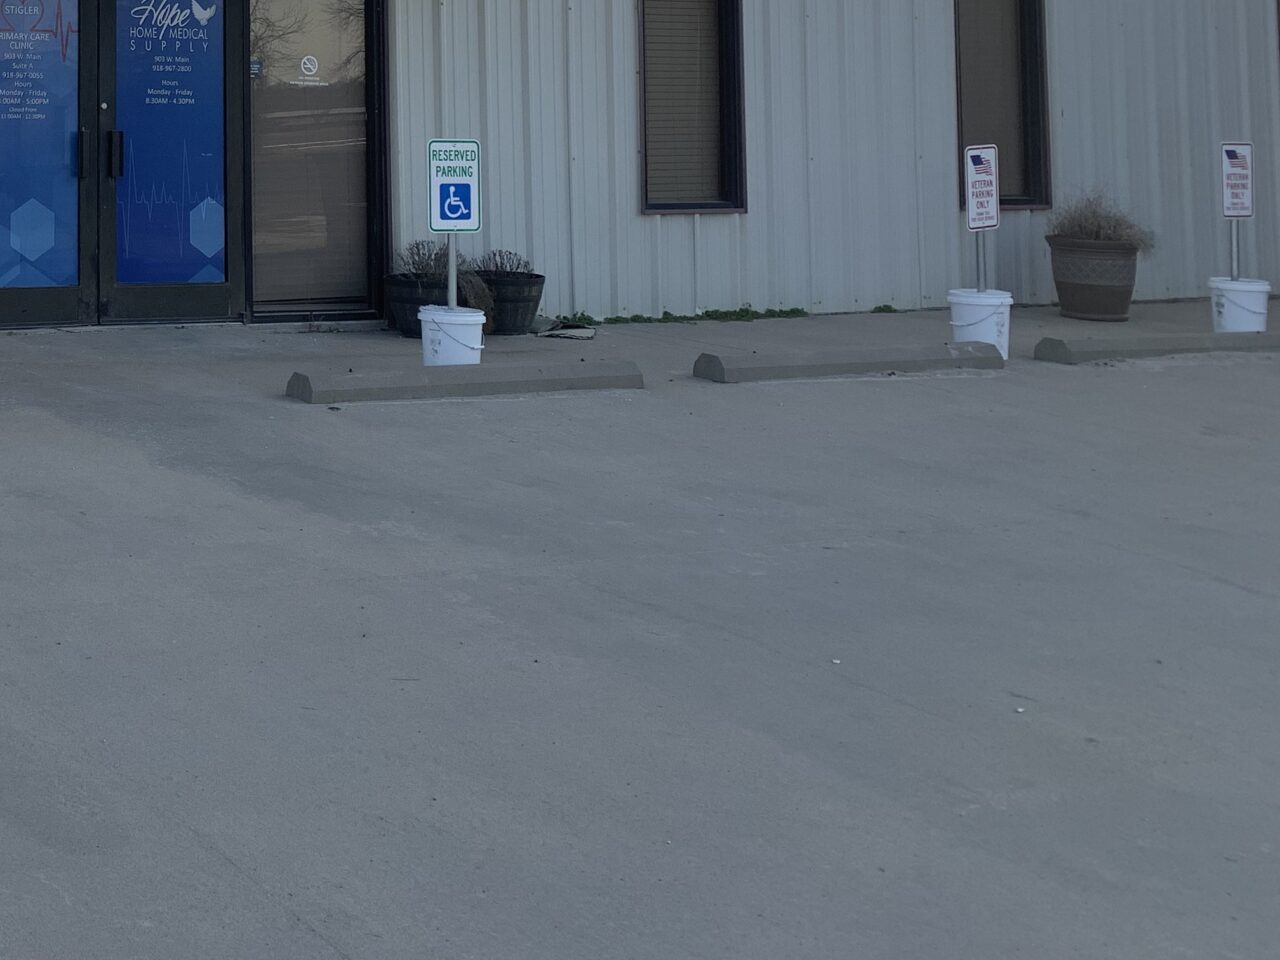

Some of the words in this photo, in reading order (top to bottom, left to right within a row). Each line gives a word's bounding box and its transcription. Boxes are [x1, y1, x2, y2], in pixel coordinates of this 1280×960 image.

[5, 6, 40, 15] STIGLER
[30, 33, 50, 41] CARE
[130, 27, 158, 38] HOME
[169, 28, 208, 40] MEDICAL
[10, 42, 34, 50] CLINIC
[130, 40, 208, 52] SUPPLY
[14, 80, 32, 88] Hours
[0, 89, 24, 98] Monday
[28, 90, 47, 98] Friday
[148, 88, 171, 96] Monday
[432, 150, 476, 162] RESERVED
[436, 166, 473, 178] PARKING
[972, 179, 993, 190] VETERAN
[972, 189, 994, 200] PARKING
[976, 200, 990, 209] ONLY
